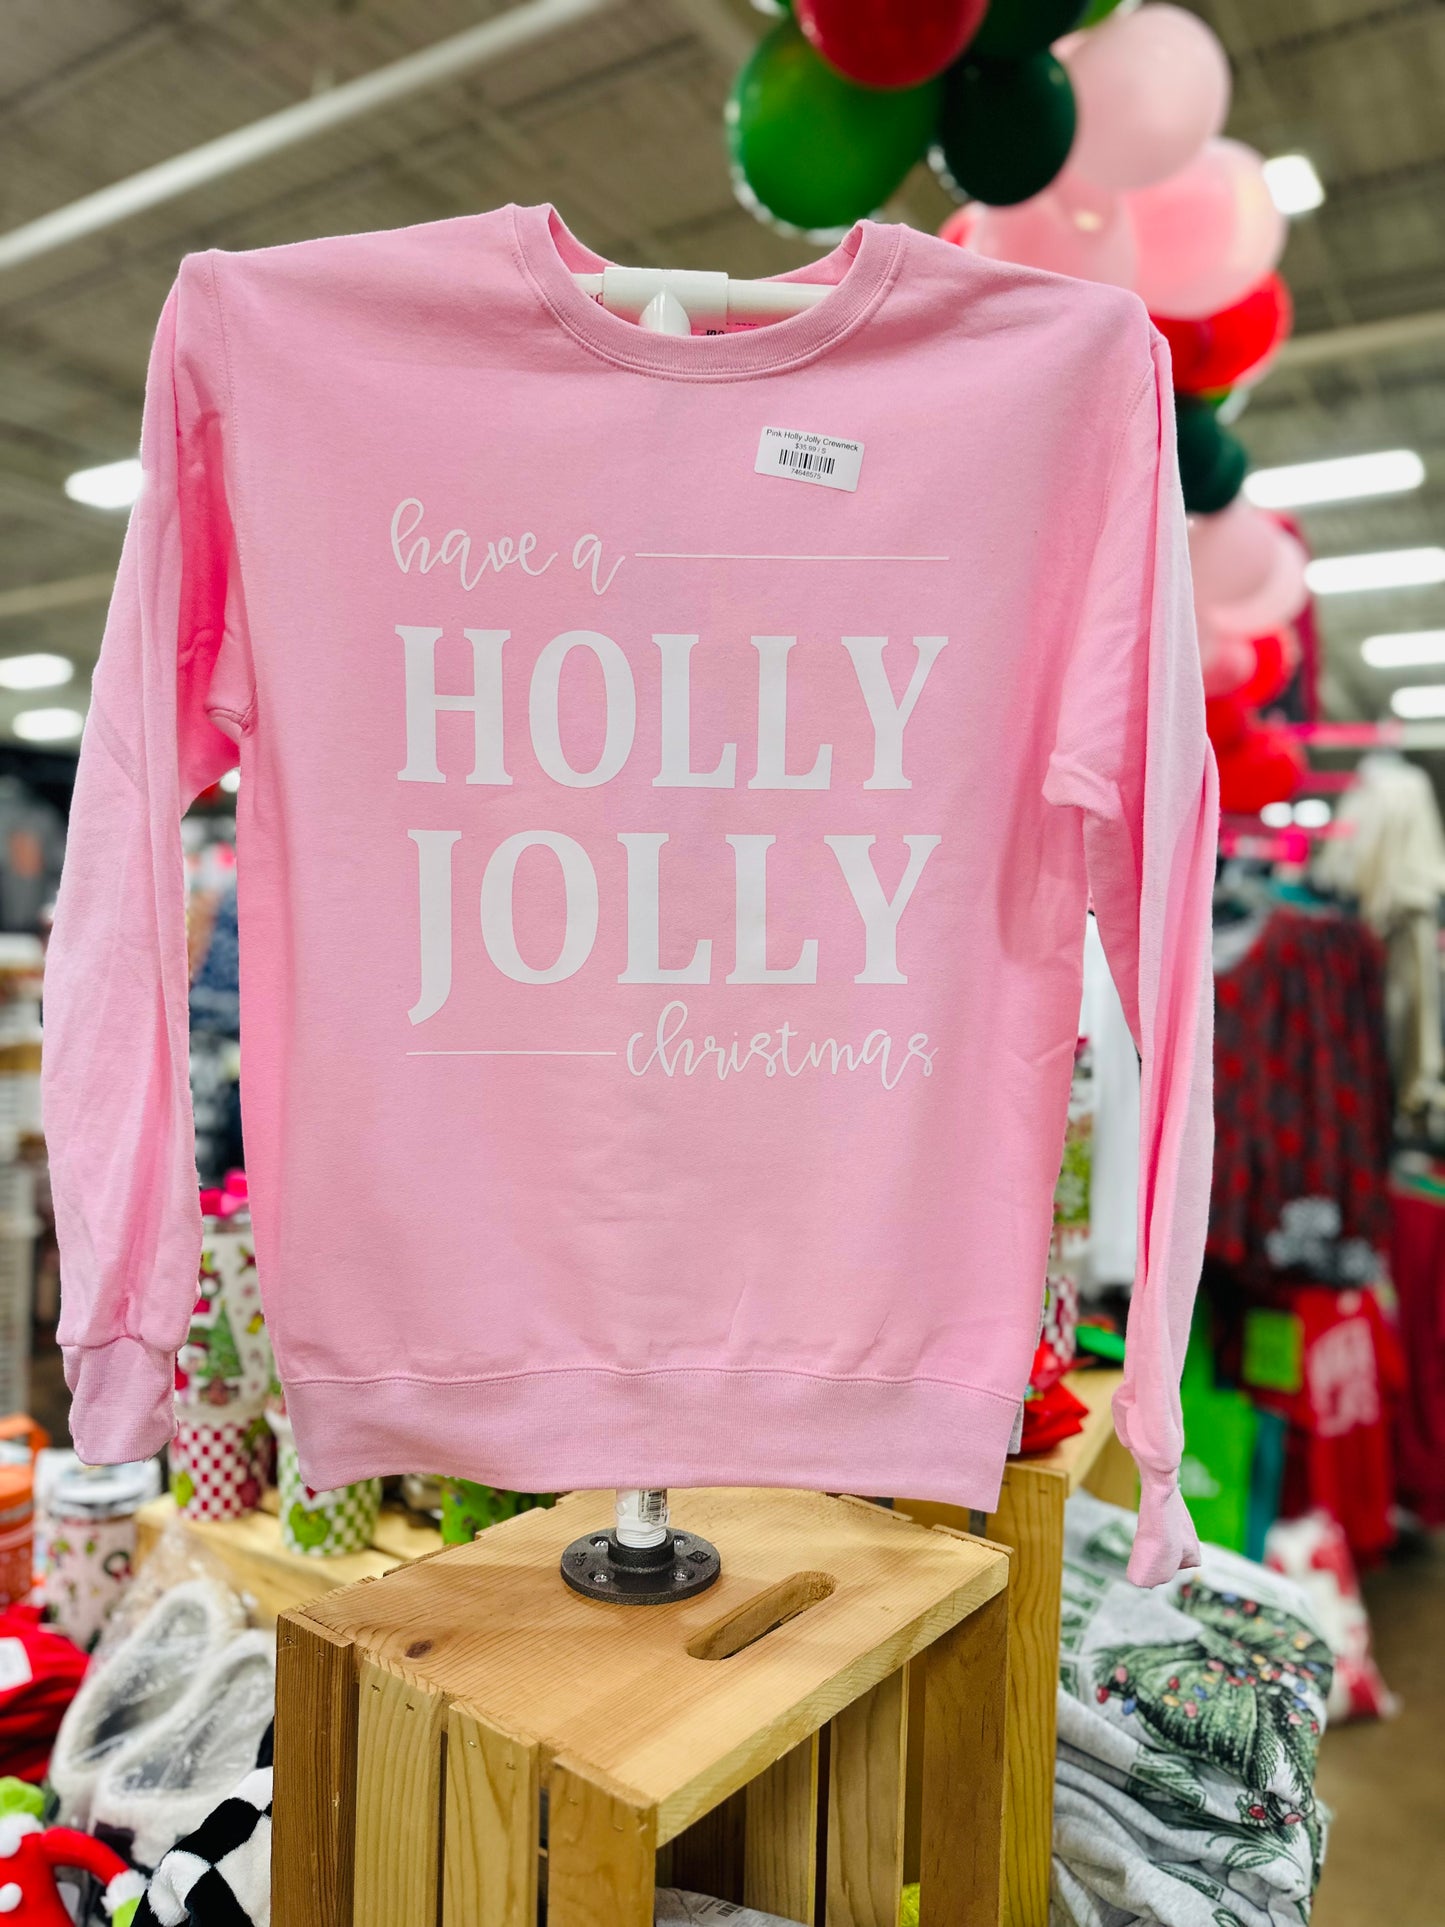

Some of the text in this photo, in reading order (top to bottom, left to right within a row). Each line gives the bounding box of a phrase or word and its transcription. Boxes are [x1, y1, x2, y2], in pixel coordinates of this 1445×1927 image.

[766, 428, 858, 452] Pink Holly Jolly Crewneck
[390, 497, 626, 595] have a
[395, 624, 950, 791] HOLLY
[407, 829, 942, 1027] JOLLY
[626, 1000, 938, 1091] christmas
